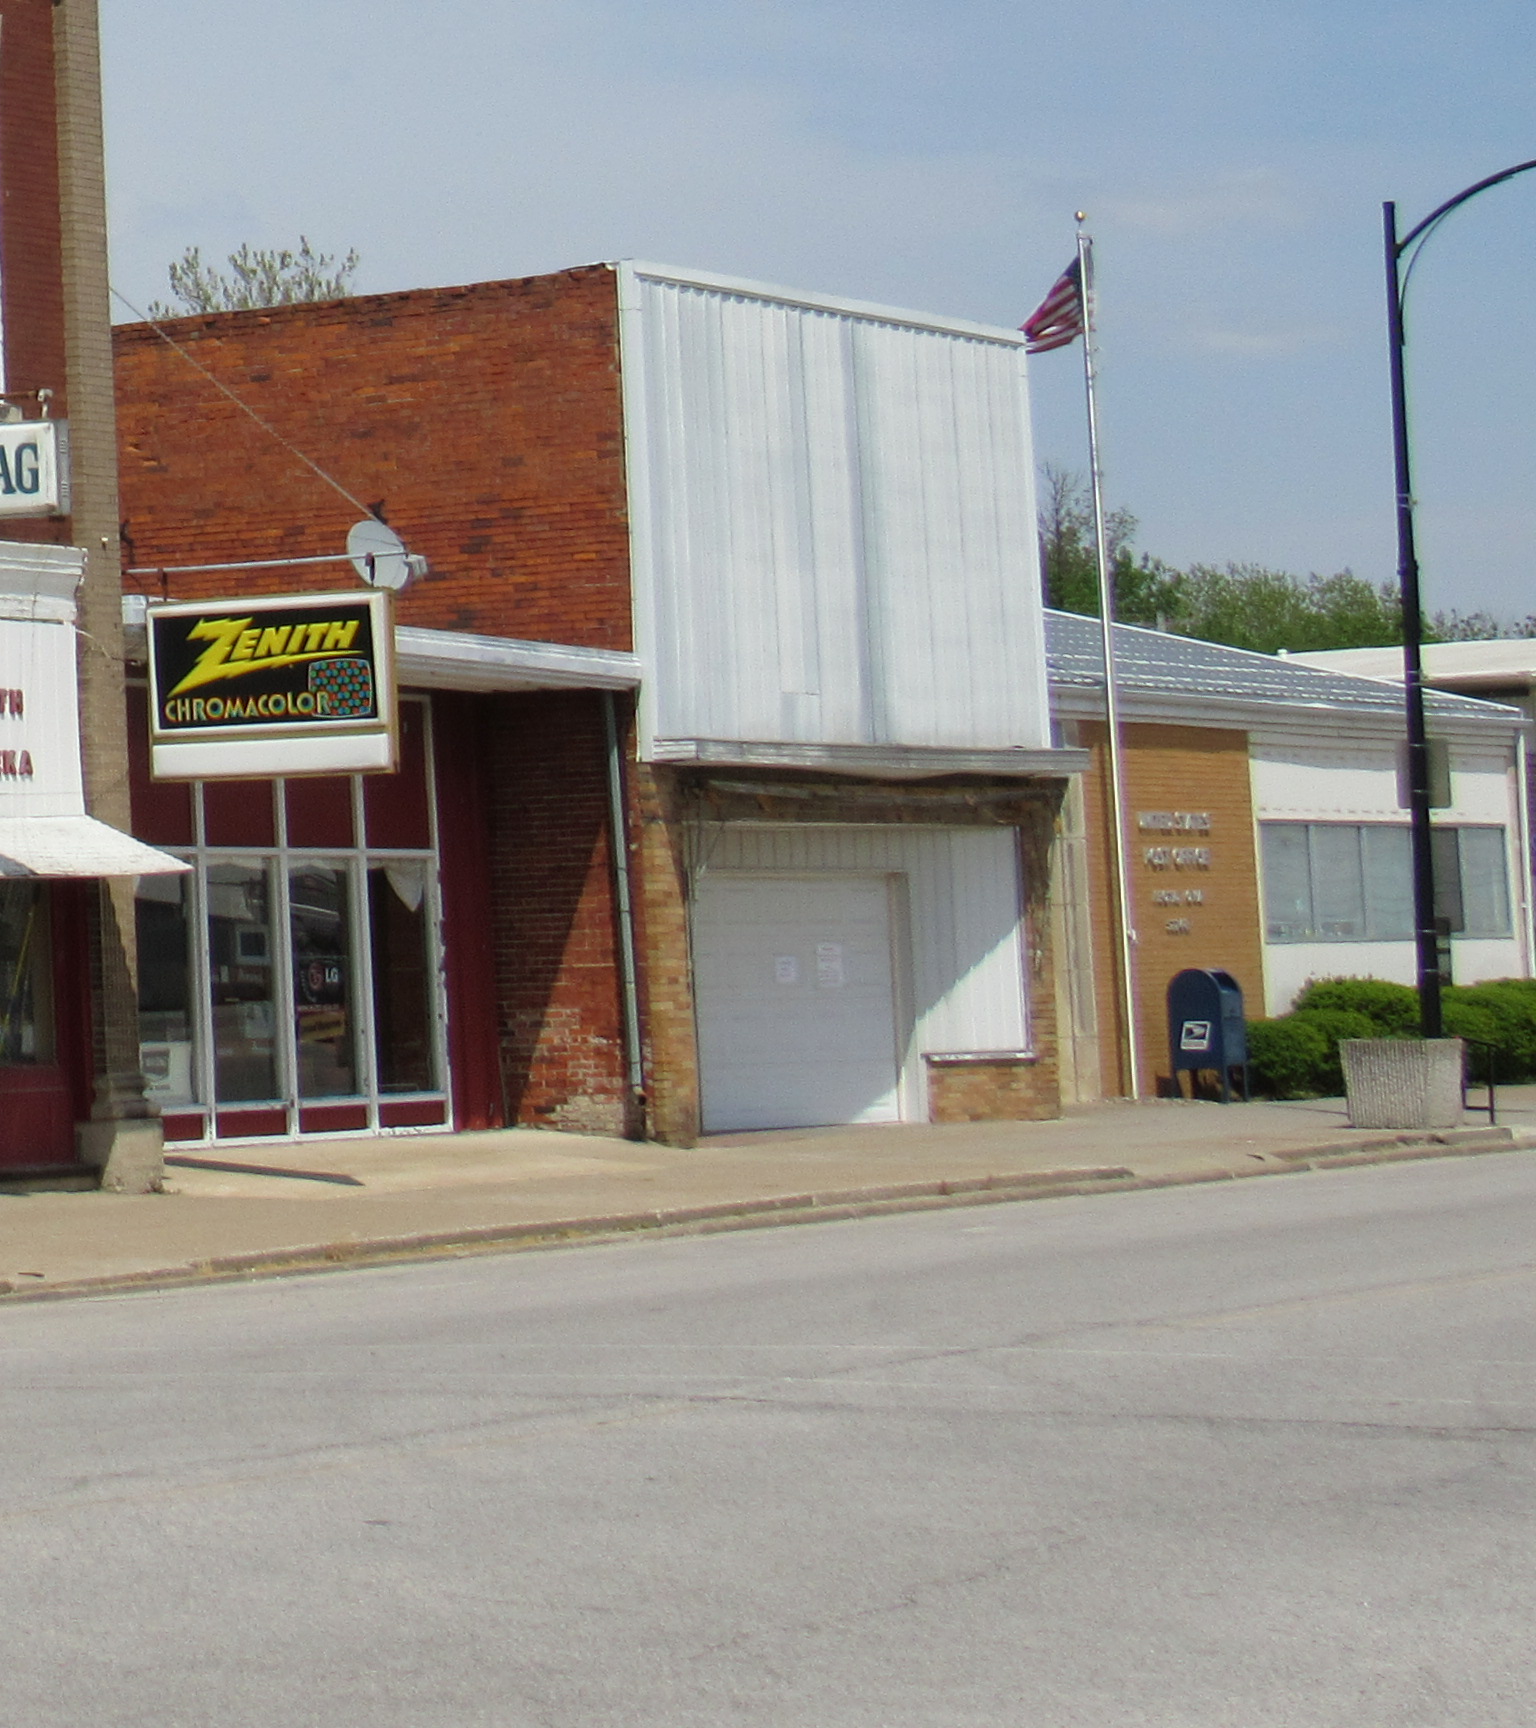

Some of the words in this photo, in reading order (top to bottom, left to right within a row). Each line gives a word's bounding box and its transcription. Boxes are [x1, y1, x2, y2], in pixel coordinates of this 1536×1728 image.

[168, 616, 363, 698] ZENITH
[164, 690, 330, 722] CHROMACOLOR
[324, 967, 339, 983] LG
